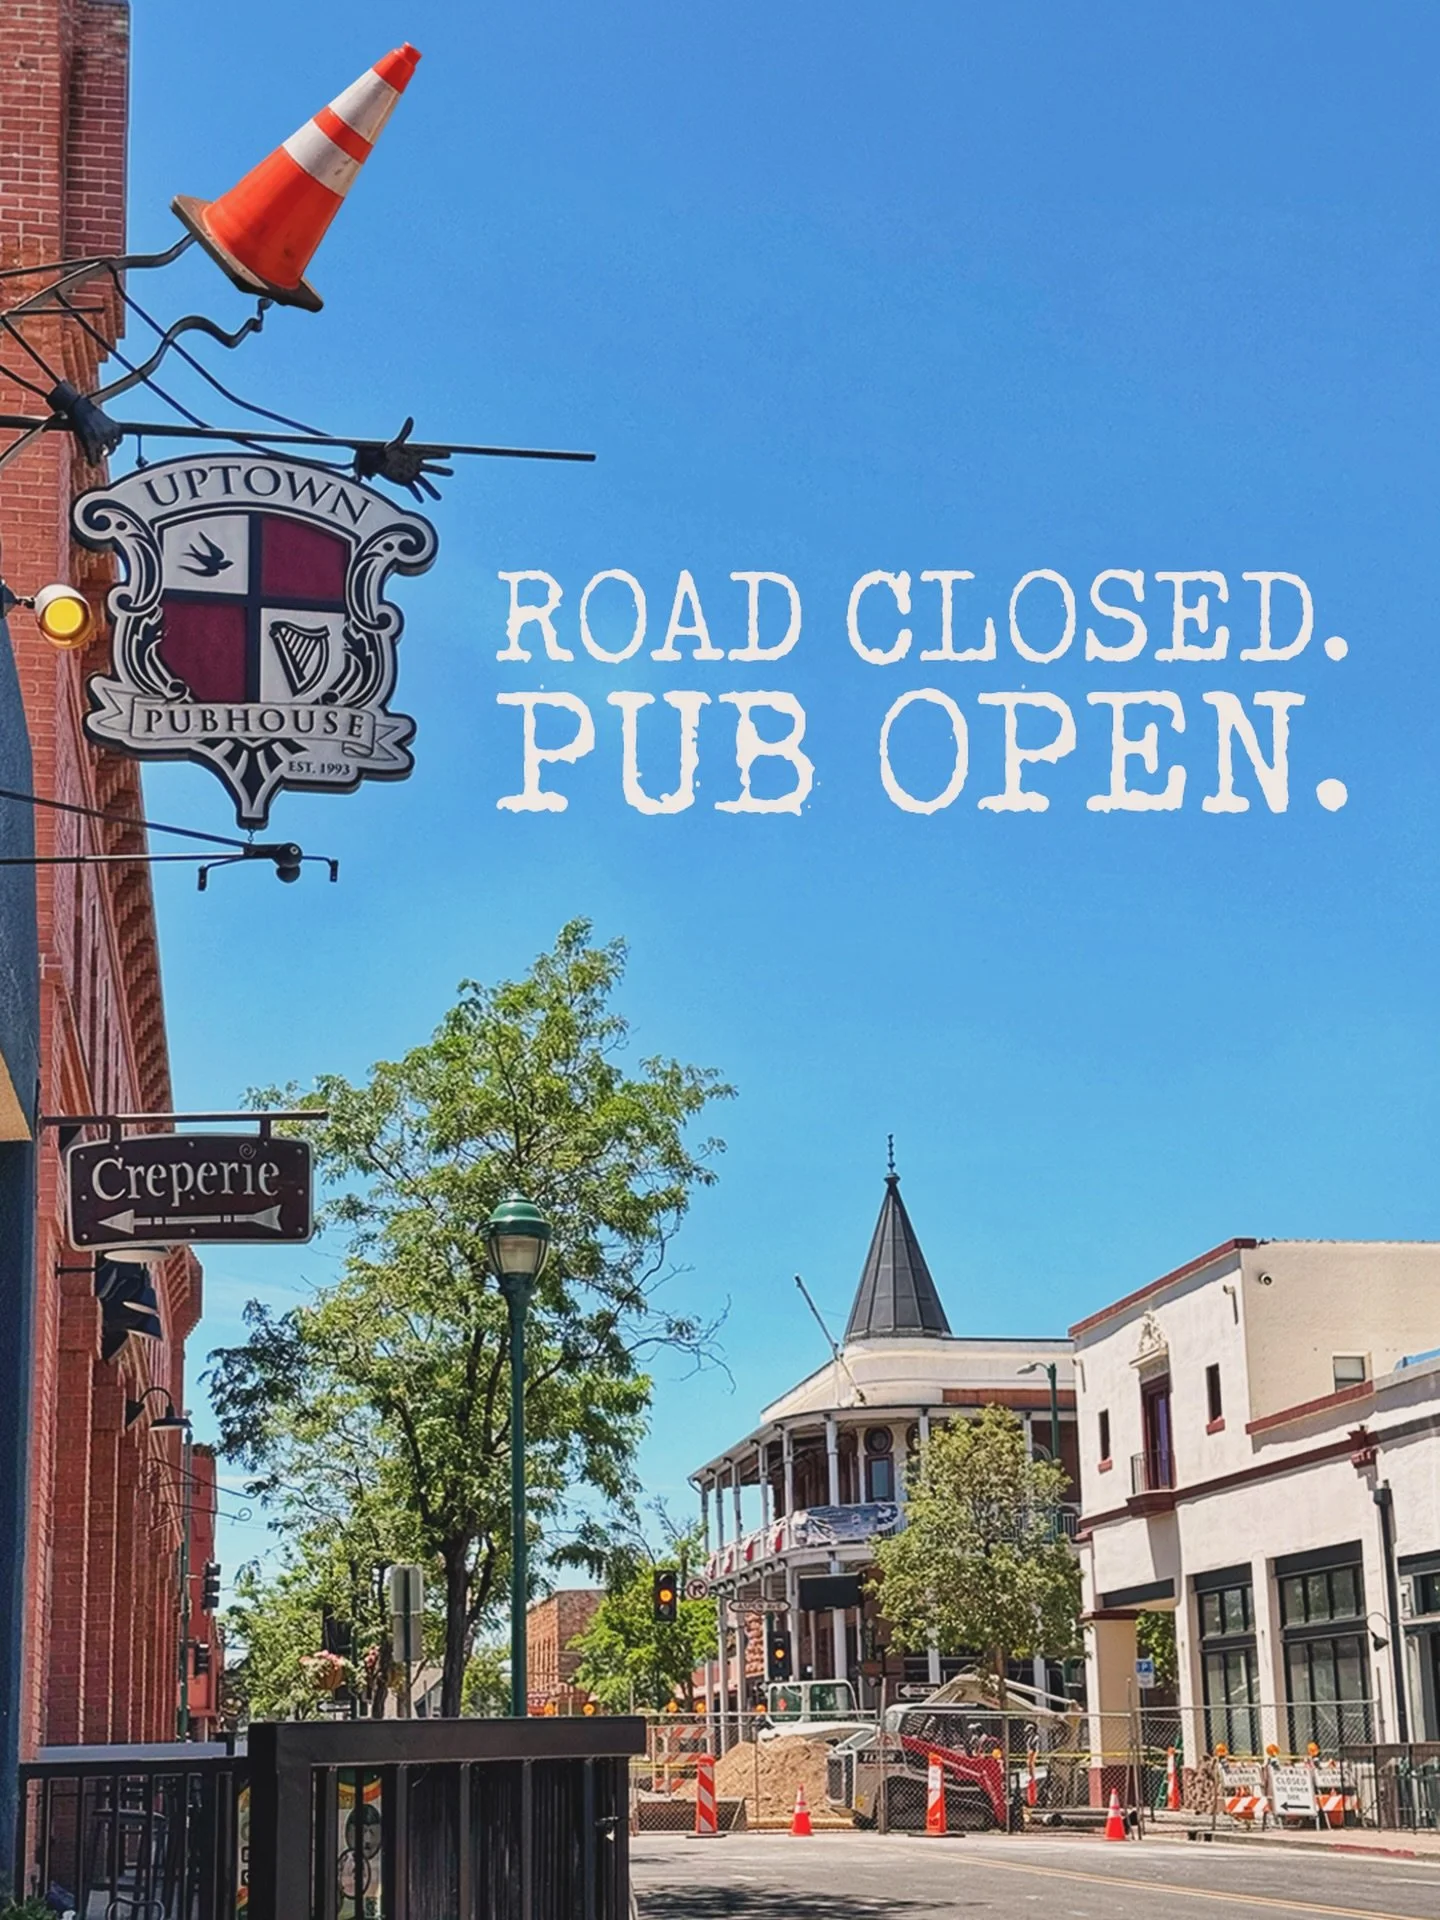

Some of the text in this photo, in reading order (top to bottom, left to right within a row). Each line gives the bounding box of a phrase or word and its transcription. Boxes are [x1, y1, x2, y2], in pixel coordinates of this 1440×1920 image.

[142, 465, 371, 525] UPTOWN
[144, 708, 365, 738] PUBHOUSE
[288, 761, 351, 776] EST. 1993
[92, 1156, 281, 1207] Creperie
[737, 1602, 764, 1610] ASPEN
[1225, 1768, 1257, 1776] IDEWALK
[1275, 1776, 1307, 1786] CLOSED
